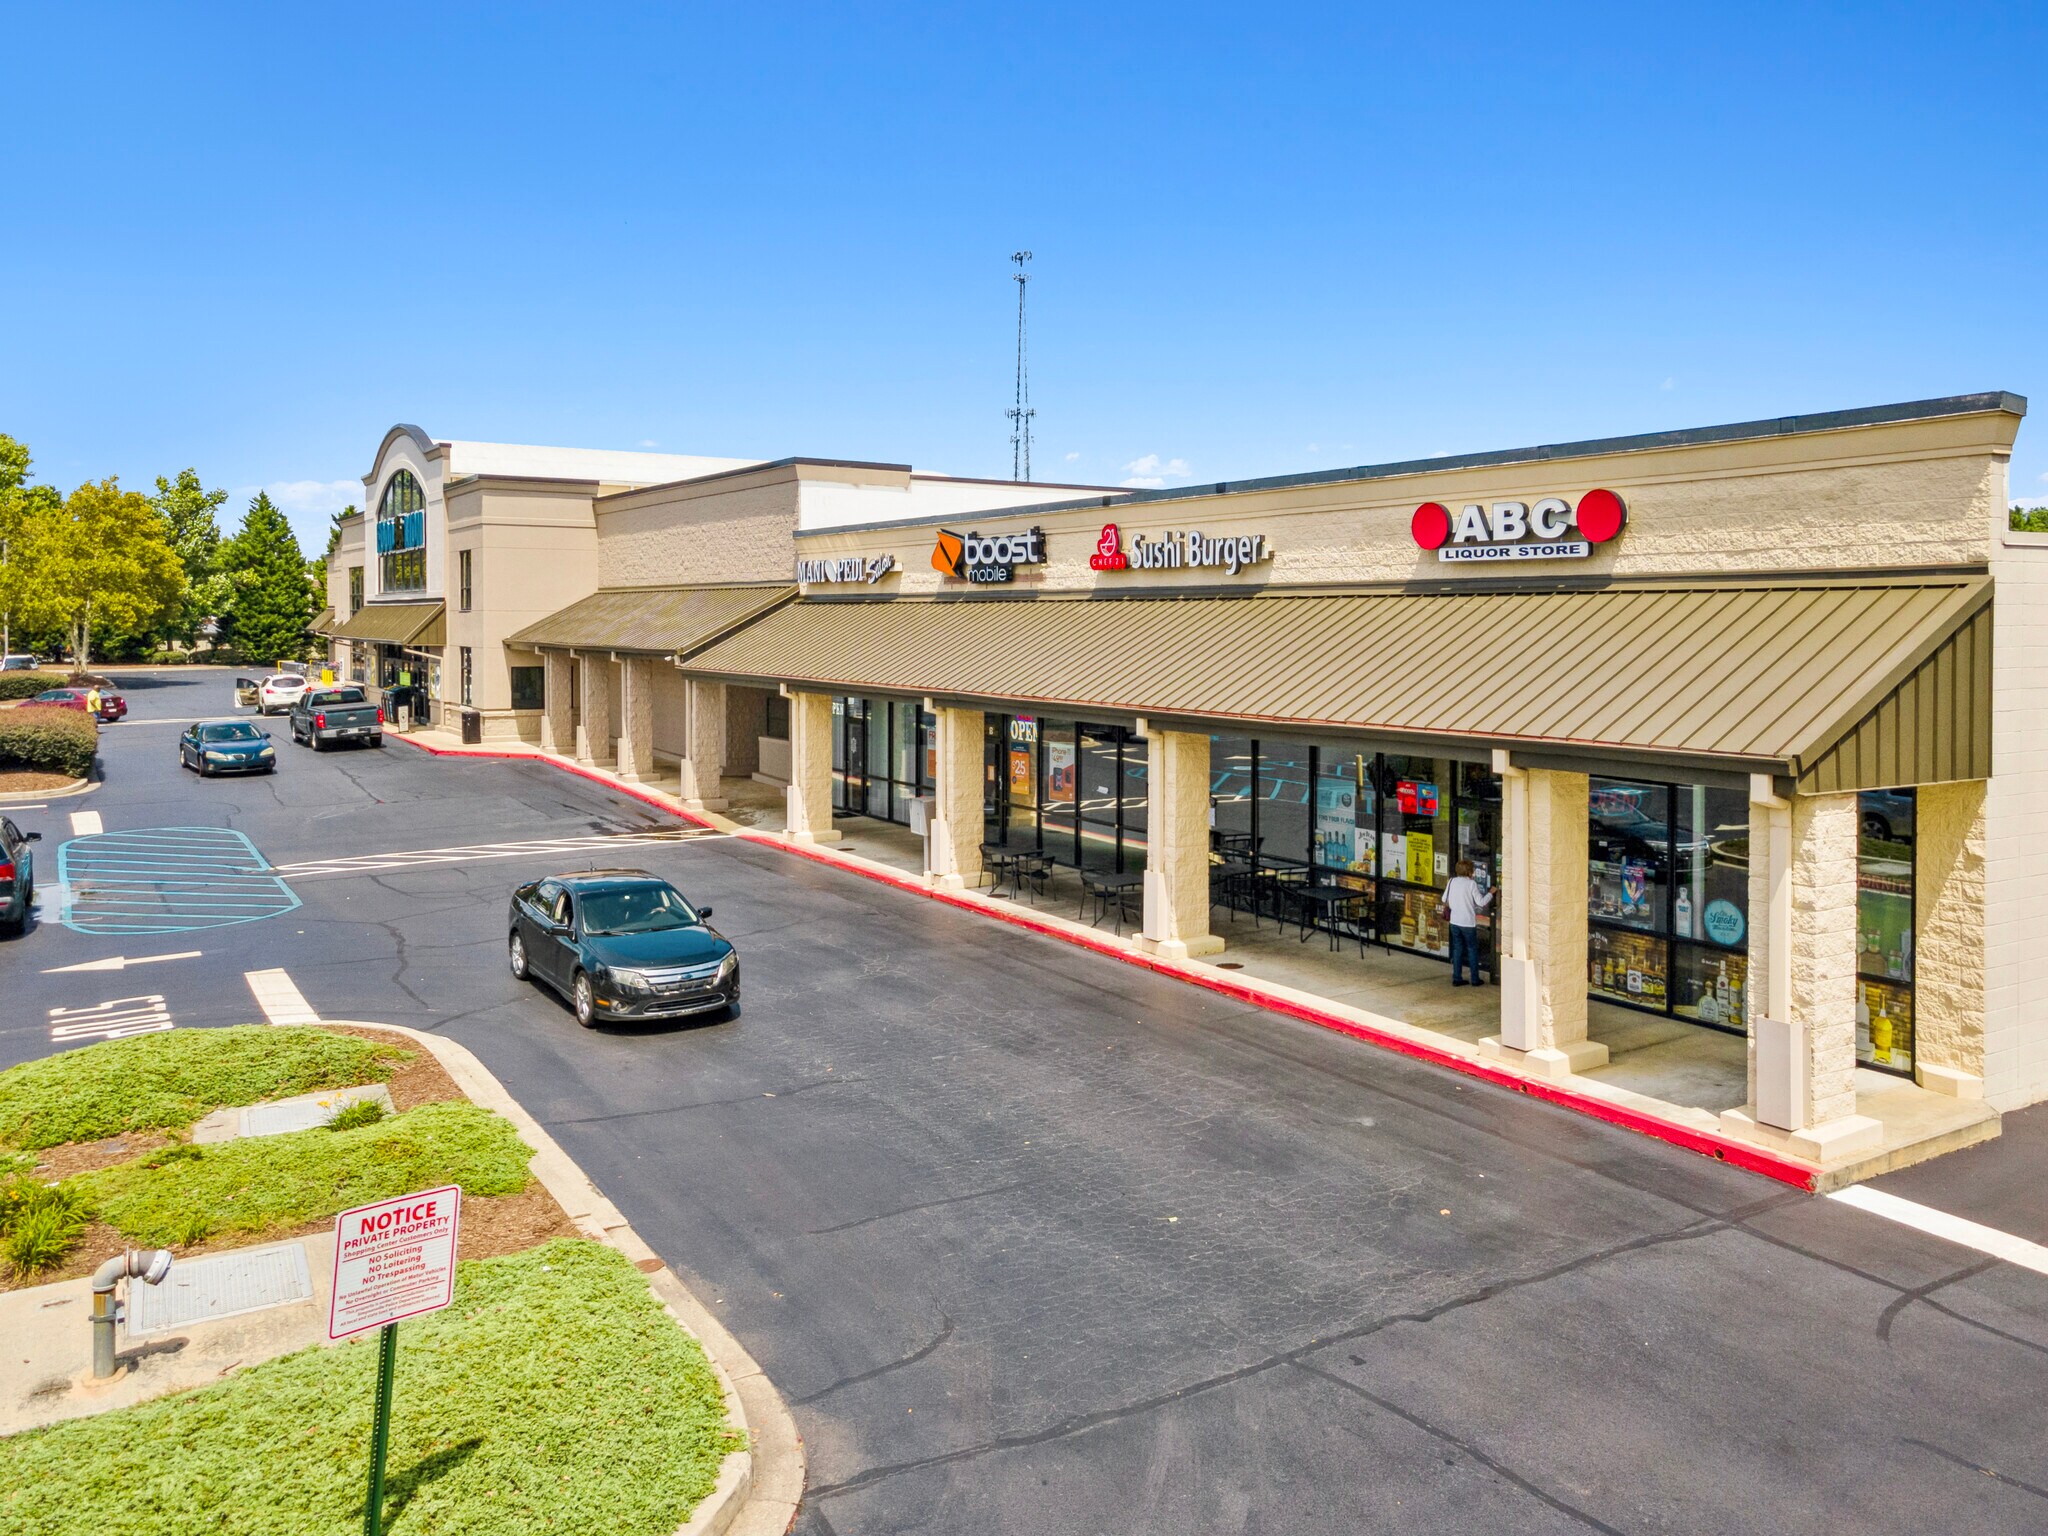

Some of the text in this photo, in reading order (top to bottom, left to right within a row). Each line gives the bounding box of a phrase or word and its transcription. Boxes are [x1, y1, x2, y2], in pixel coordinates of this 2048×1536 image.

[1453, 497, 1571, 543] ABC
[964, 528, 1039, 565] boost
[1131, 530, 1264, 575] Sushi Burger
[1445, 544, 1581, 559] LIQUOR STORE
[797, 559, 826, 583] MANI
[837, 557, 865, 582] PEDI
[968, 565, 1007, 582] mobile
[1092, 557, 1113, 566] CHEF
[831, 702, 844, 716] PEN
[361, 1201, 437, 1235] NOTICE
[343, 1227, 449, 1259] Shopping Center Customers Only
[344, 1215, 450, 1250] PRIVATE PROPERTY
[368, 1255, 422, 1274] NO Loitering
[369, 1245, 423, 1265] NO Soliciting
[362, 1263, 426, 1285] NO Trespassing
[373, 1280, 400, 1290] Operation
[425, 1266, 447, 1276] Vehicles
[354, 1291, 381, 1302] Overnight
[418, 1275, 440, 1284] Parking
